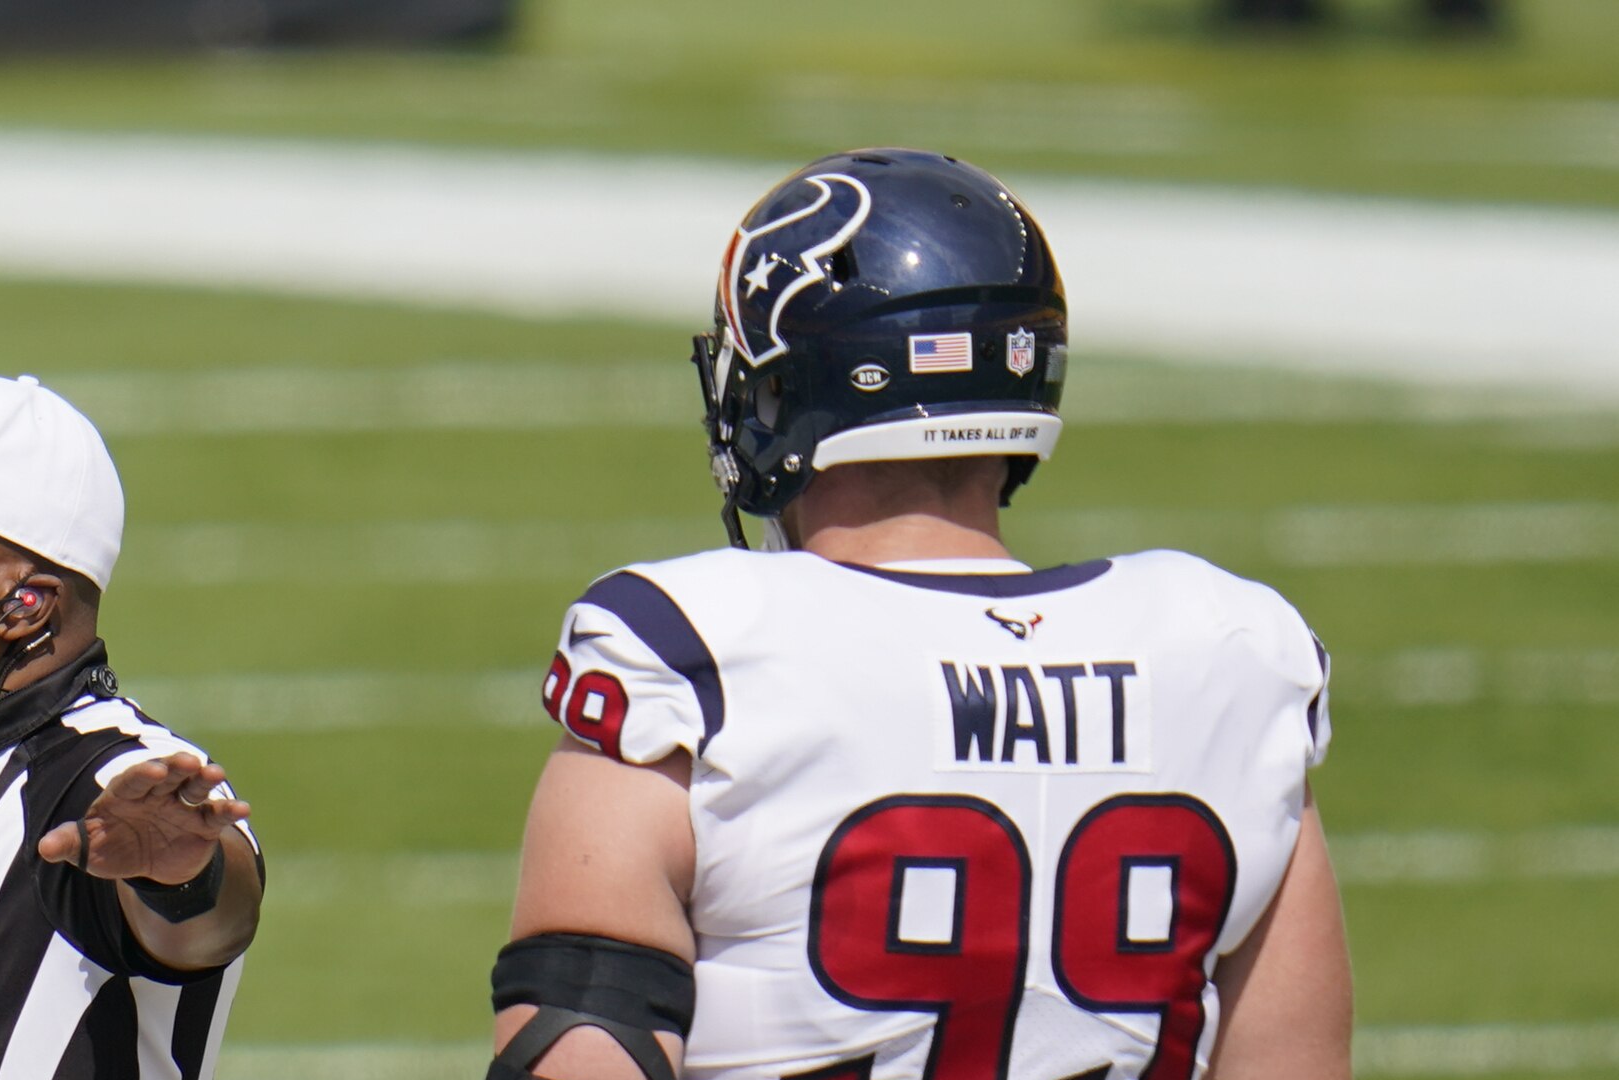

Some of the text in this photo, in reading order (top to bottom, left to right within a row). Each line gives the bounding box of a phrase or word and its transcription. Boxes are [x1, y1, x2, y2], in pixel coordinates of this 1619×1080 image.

[924, 430, 937, 441] IT
[941, 428, 982, 440] TAKES
[986, 426, 1005, 440] ALL
[1009, 426, 1023, 440] OF
[940, 660, 1138, 764] WATT
